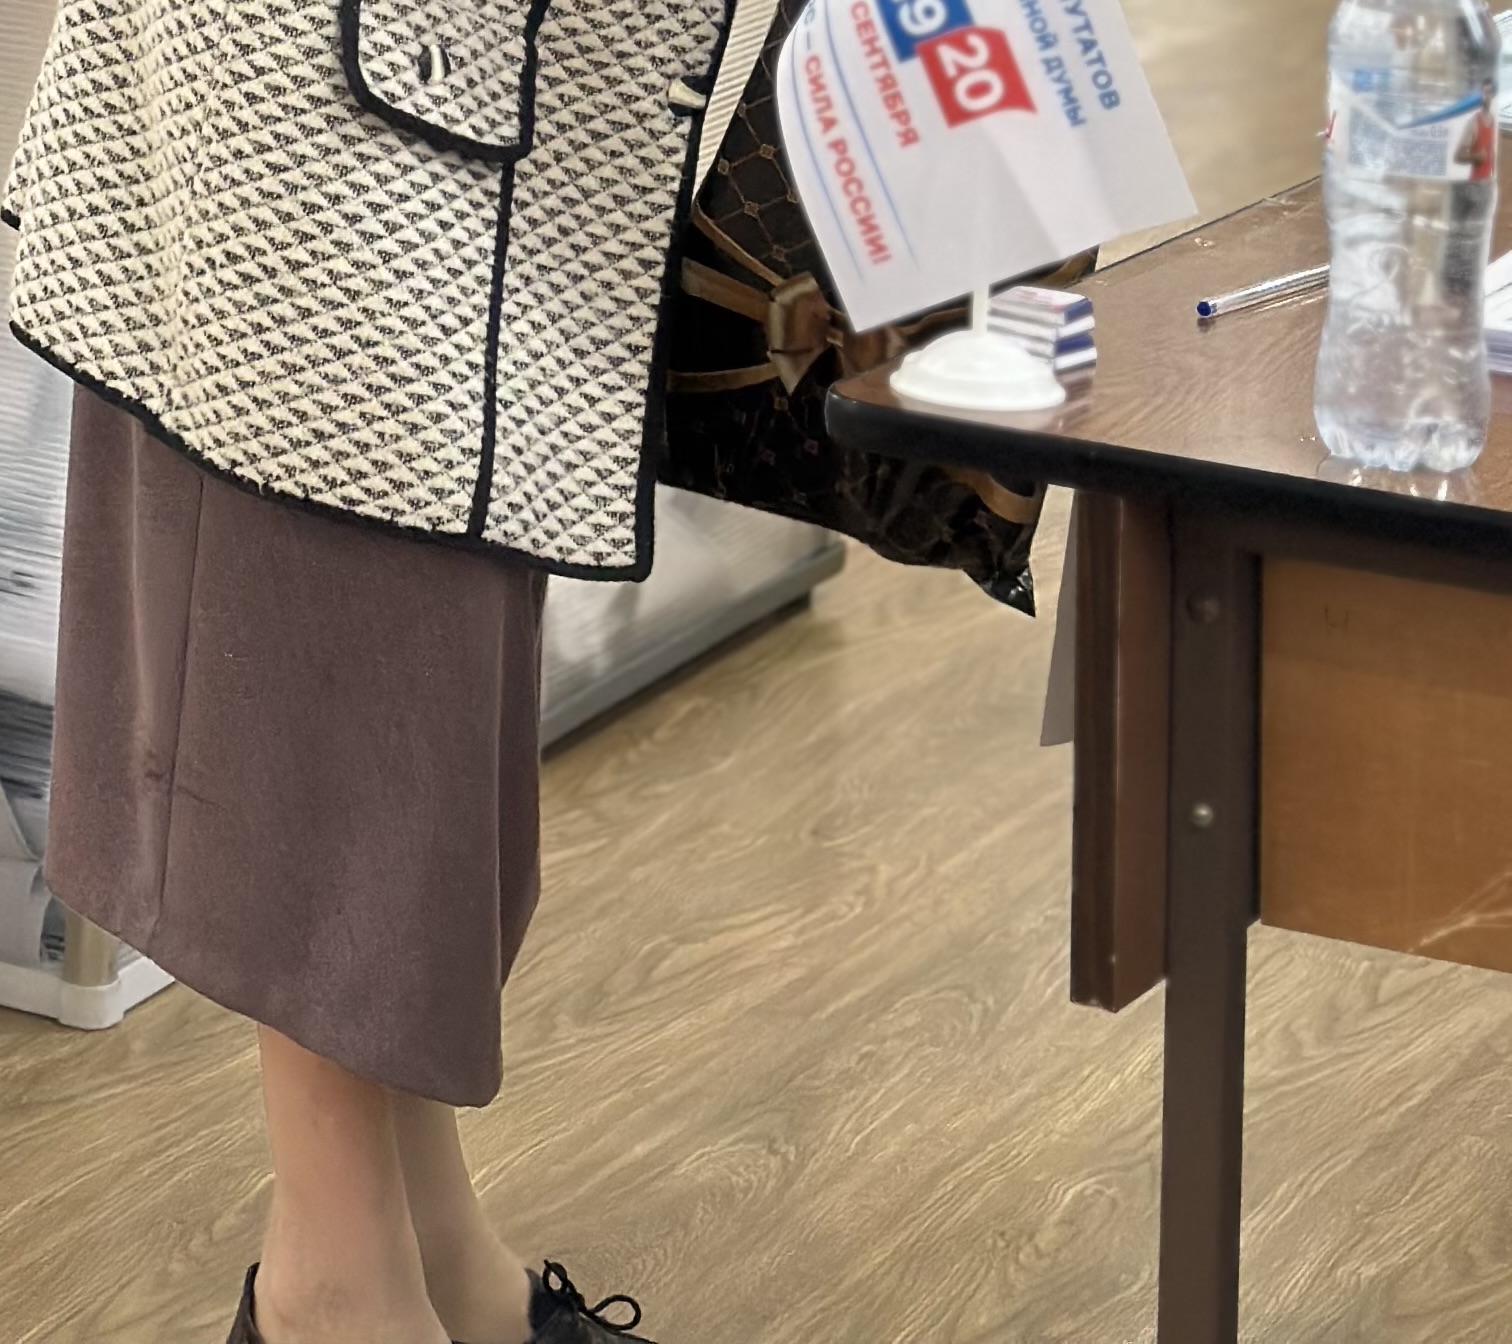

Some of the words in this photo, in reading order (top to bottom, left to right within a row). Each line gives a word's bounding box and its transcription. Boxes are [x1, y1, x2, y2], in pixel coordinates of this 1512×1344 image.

[850, 0, 920, 148] СЕНТЯБРЯ
[936, 33, 1006, 112] 20
[1041, 54, 1086, 128] ДУМЫ
[804, 55, 840, 134] СИЛА
[827, 137, 893, 265] РОССИИ!
